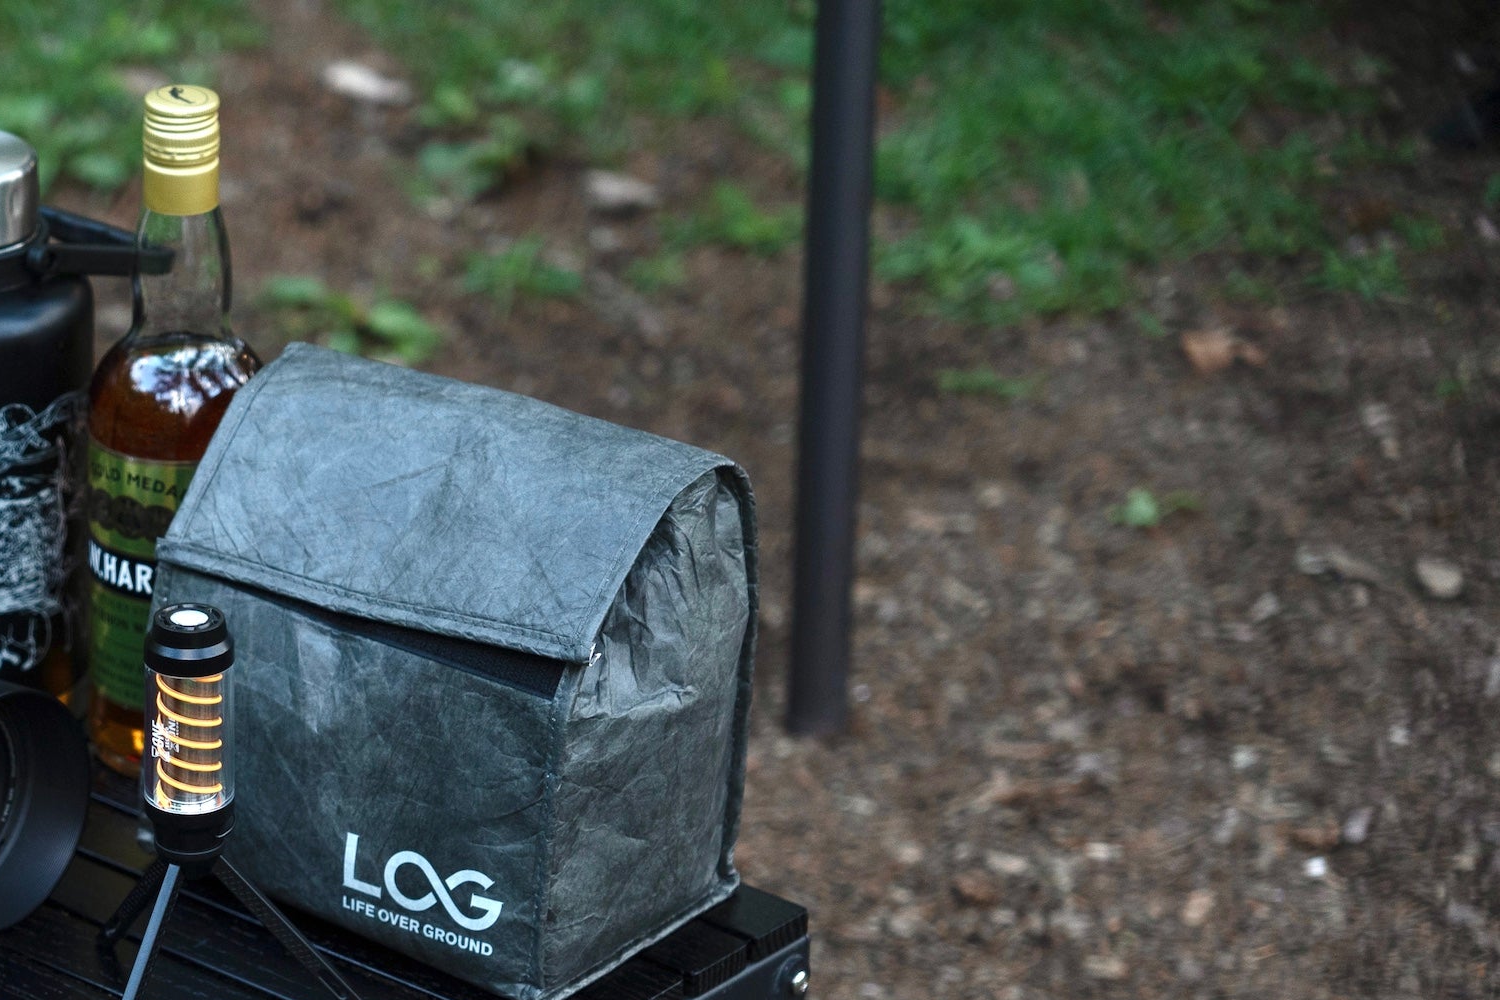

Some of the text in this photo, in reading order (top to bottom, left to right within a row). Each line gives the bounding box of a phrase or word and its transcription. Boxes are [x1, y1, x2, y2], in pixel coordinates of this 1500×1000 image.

[342, 831, 504, 931] LOG
[342, 896, 494, 957] LIFE OVER GROUND
